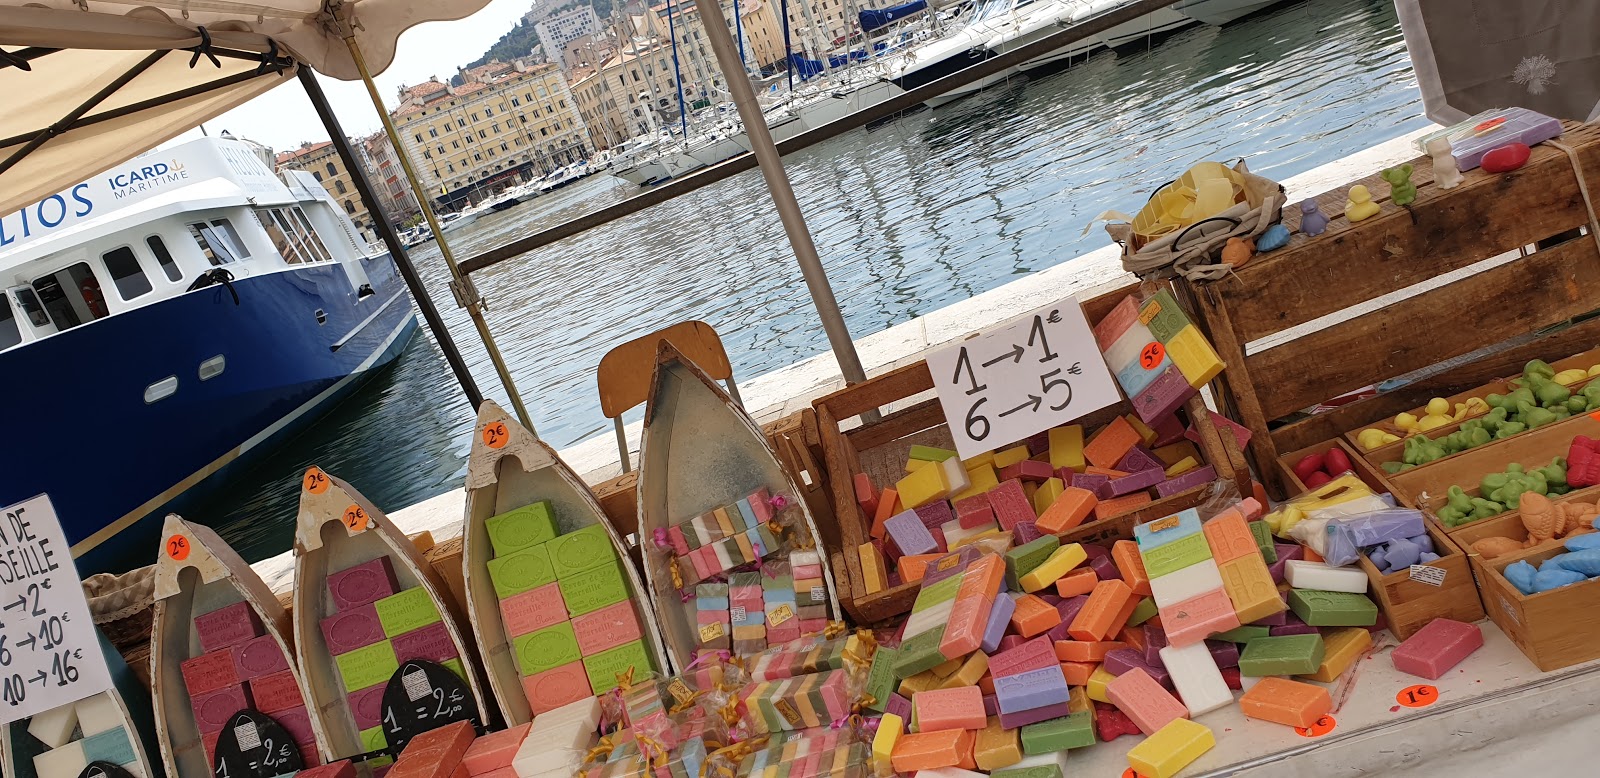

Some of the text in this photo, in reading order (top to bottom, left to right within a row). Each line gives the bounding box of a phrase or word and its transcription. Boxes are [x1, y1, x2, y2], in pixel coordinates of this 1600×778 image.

[108, 163, 168, 190] ICARD
[114, 170, 188, 199] MARITIME
[1144, 344, 1160, 368] 5€
[952, 347, 987, 396] 1
[965, 361, 1083, 442] 6 5€
[487, 425, 504, 444] 2€
[308, 472, 324, 490] 2€
[7, 508, 36, 543] DE
[347, 508, 364, 527] 2€
[170, 537, 185, 557] 2€
[563, 580, 585, 591] Savon
[567, 583, 601, 598] Marseille
[27, 578, 52, 617] 2€
[504, 600, 528, 611] Savon
[508, 603, 541, 619] Marseille
[575, 617, 599, 630] Savon
[0, 612, 71, 666] 6 10€
[589, 656, 611, 667] Savon
[4, 648, 83, 706] 10 16€
[1408, 686, 1430, 704] 1€
[383, 706, 402, 733] 1
[416, 706, 428, 719] =
[214, 757, 231, 778] 1
